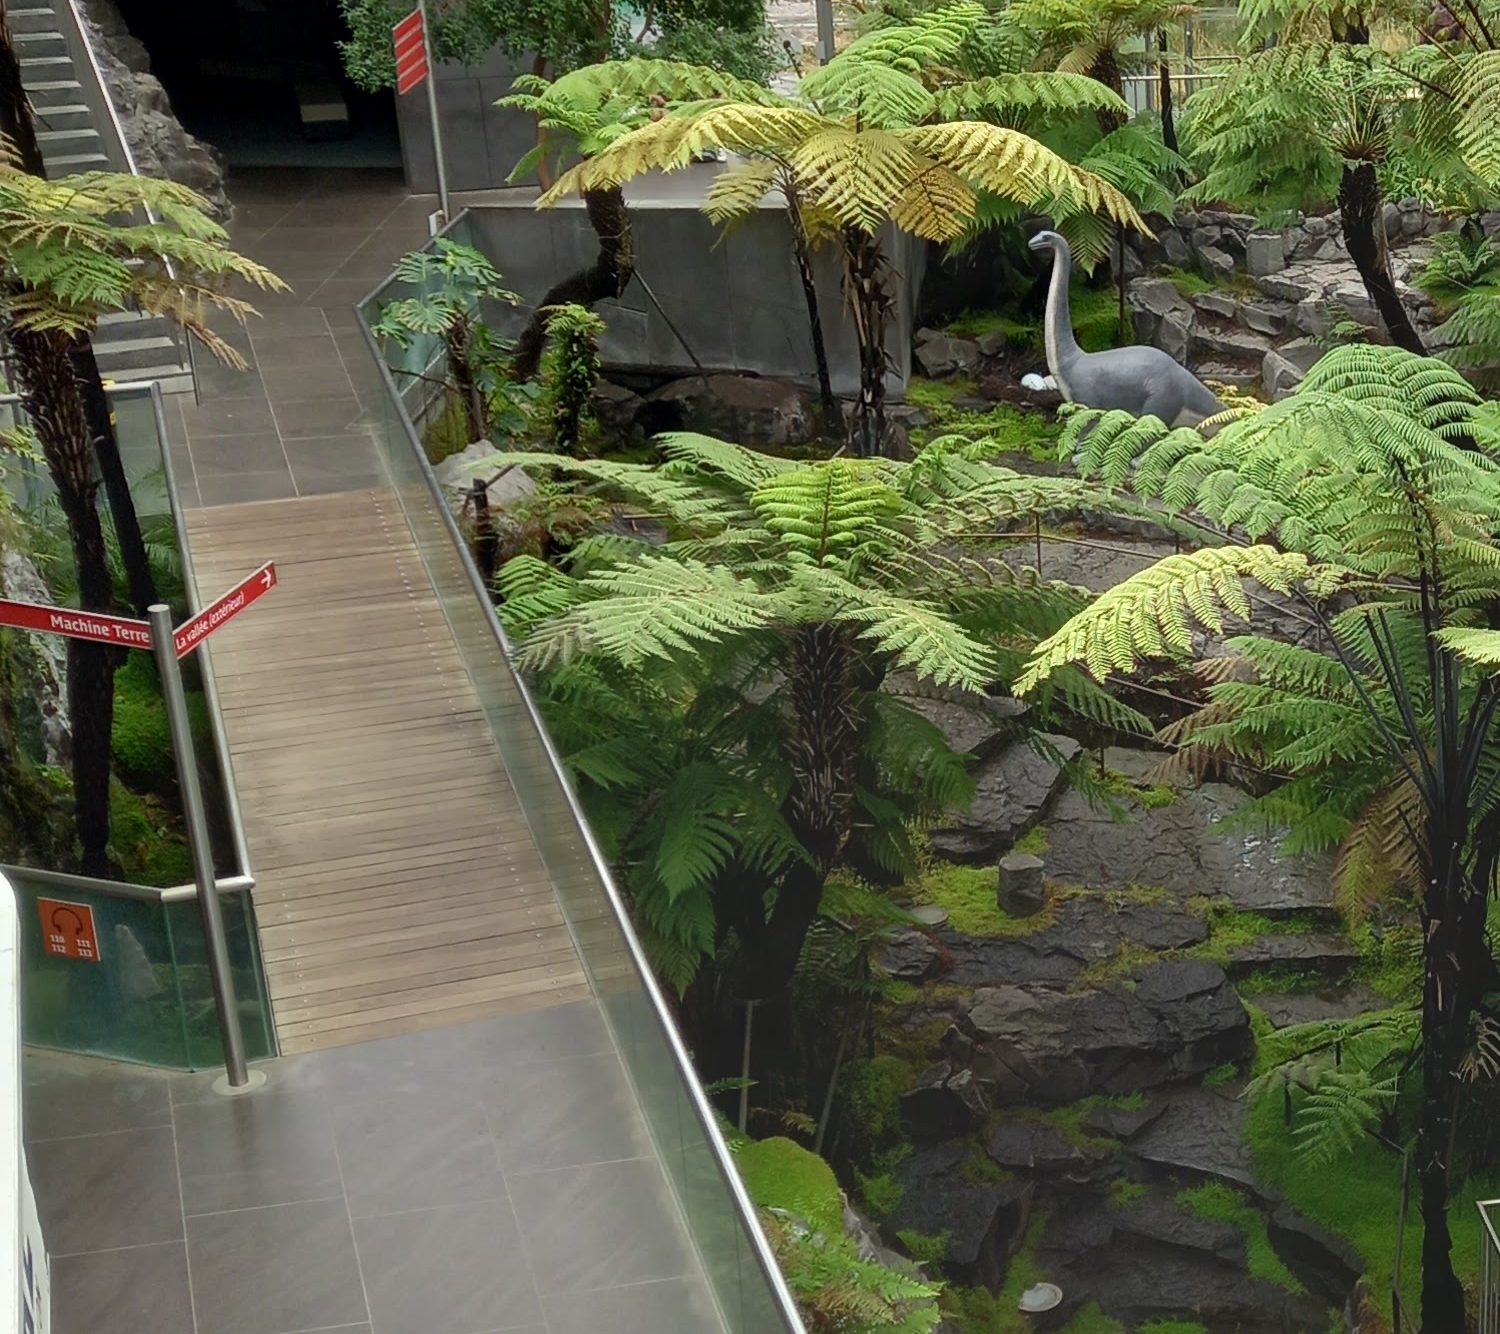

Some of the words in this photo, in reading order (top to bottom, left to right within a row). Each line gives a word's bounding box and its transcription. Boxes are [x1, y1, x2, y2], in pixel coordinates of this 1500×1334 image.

[49, 614, 110, 636] Machine
[112, 624, 150, 643] Terre
[176, 637, 187, 650] La
[186, 620, 209, 641] vallée
[208, 590, 245, 627] (extérieur)
